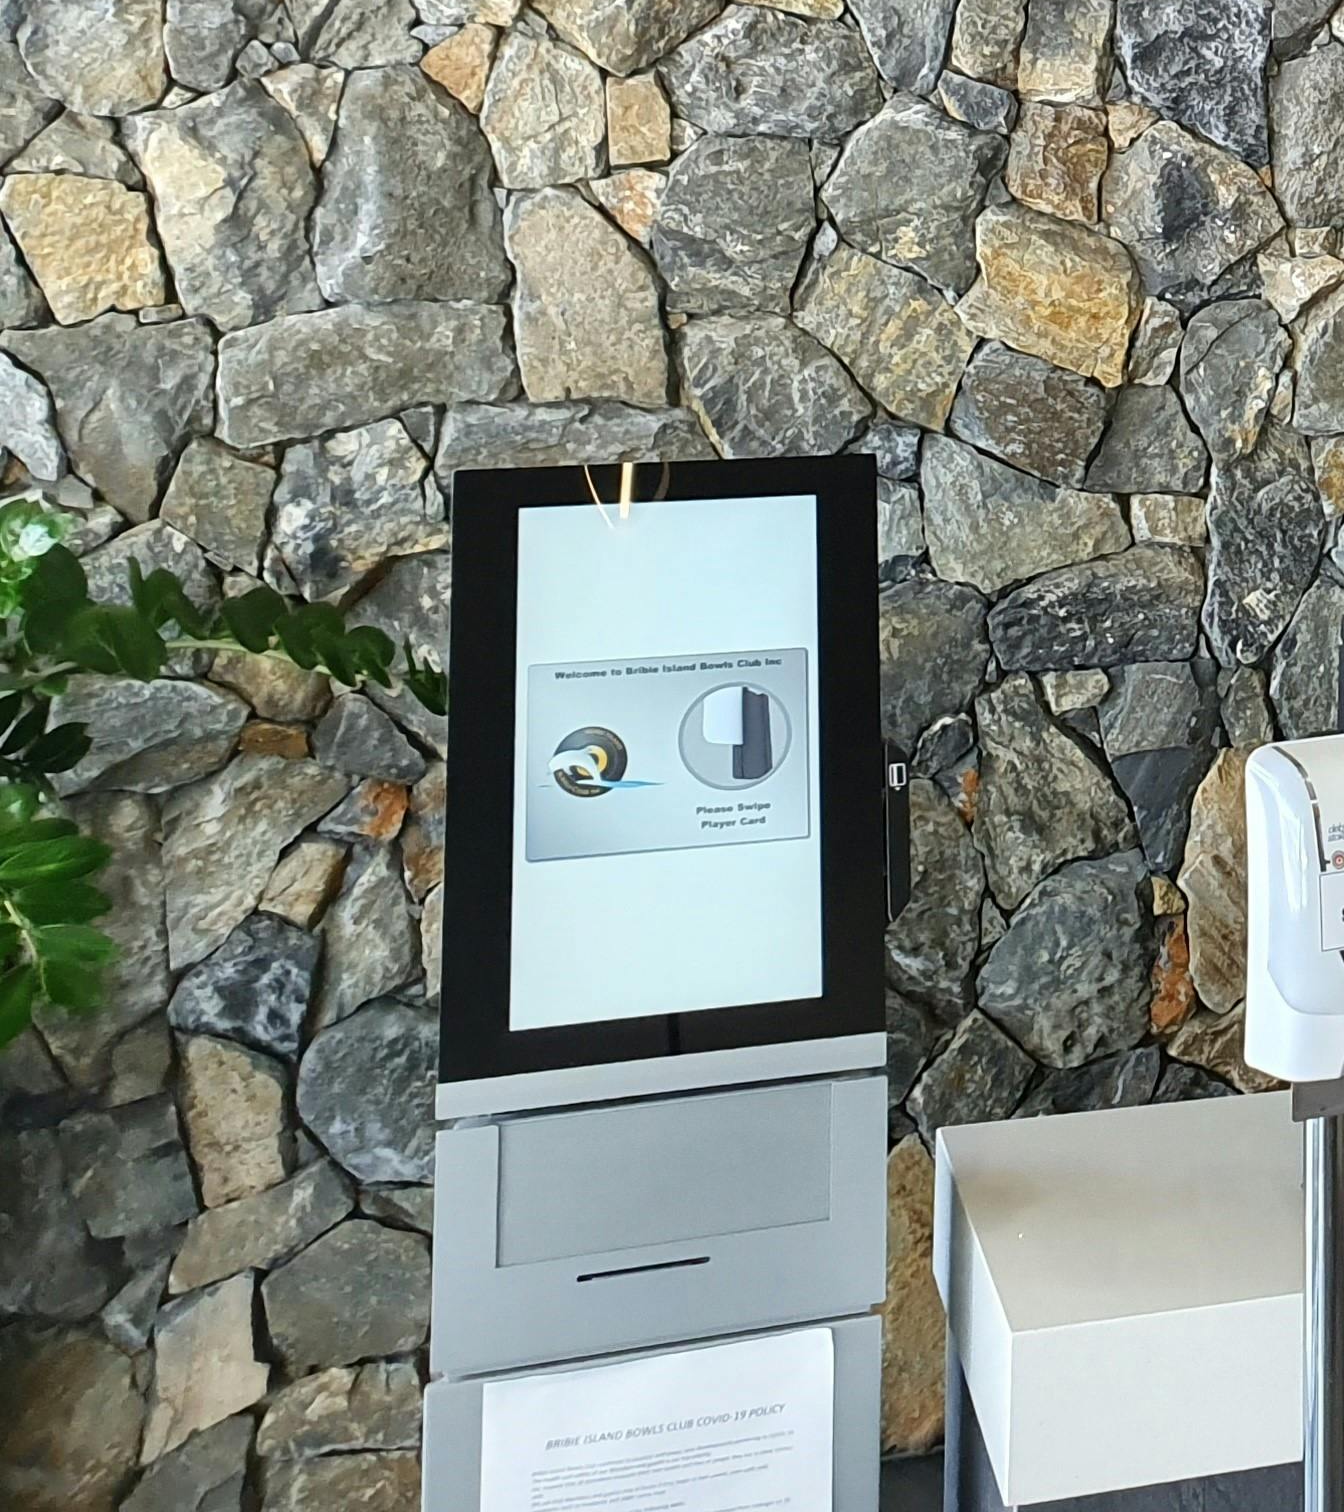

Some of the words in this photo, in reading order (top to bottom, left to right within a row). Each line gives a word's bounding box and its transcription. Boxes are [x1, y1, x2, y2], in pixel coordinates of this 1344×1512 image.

[555, 669, 607, 680] Welcome
[611, 668, 622, 676] to
[626, 665, 659, 675] Bribie
[662, 663, 696, 673] Island
[700, 661, 733, 670] Bowls
[737, 658, 761, 667] Club
[765, 657, 782, 666] Inc
[696, 804, 733, 815] Please
[737, 802, 771, 812] Swipe
[701, 818, 736, 829] Player
[740, 816, 766, 826] Card
[545, 1435, 581, 1450] BRIBIE
[583, 1430, 623, 1446] ISLAND
[625, 1424, 664, 1439] BOWLS
[666, 1419, 694, 1433] CLUB
[697, 1410, 746, 1428] COVID-19
[748, 1403, 786, 1419] POLICY
